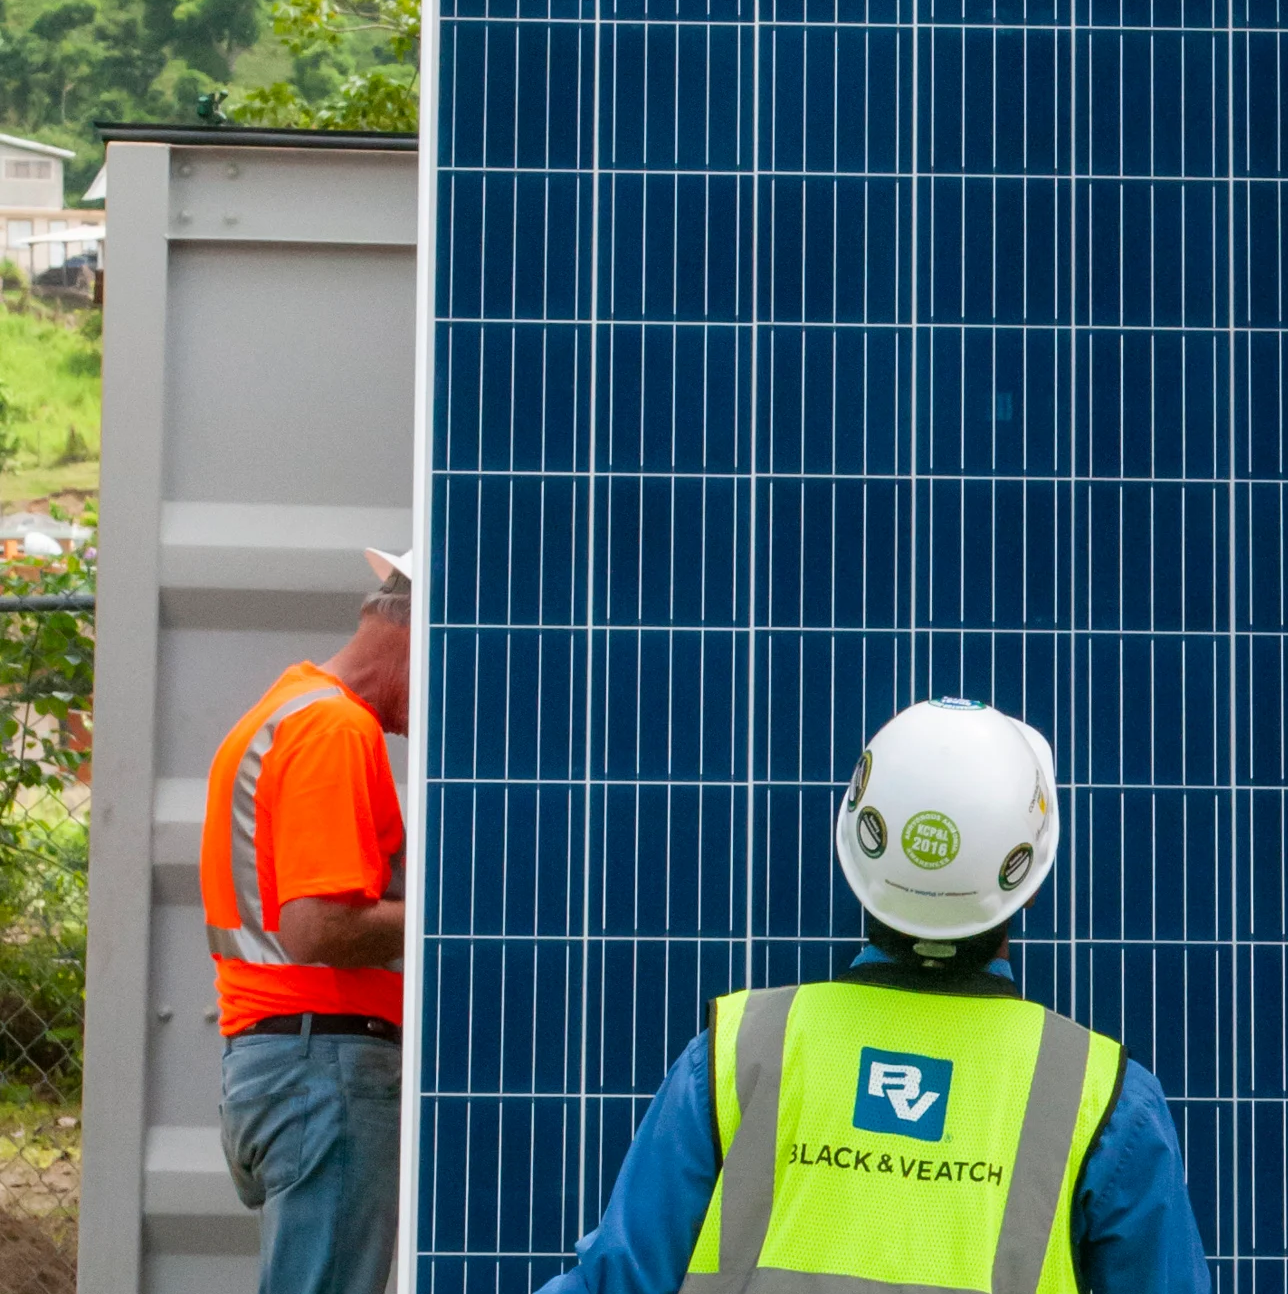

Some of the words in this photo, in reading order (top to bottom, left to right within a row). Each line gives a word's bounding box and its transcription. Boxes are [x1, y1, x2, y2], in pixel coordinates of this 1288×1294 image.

[911, 836, 948, 857] 2016
[876, 1154, 894, 1174] &
[899, 1155, 1004, 1187] VEATCH
